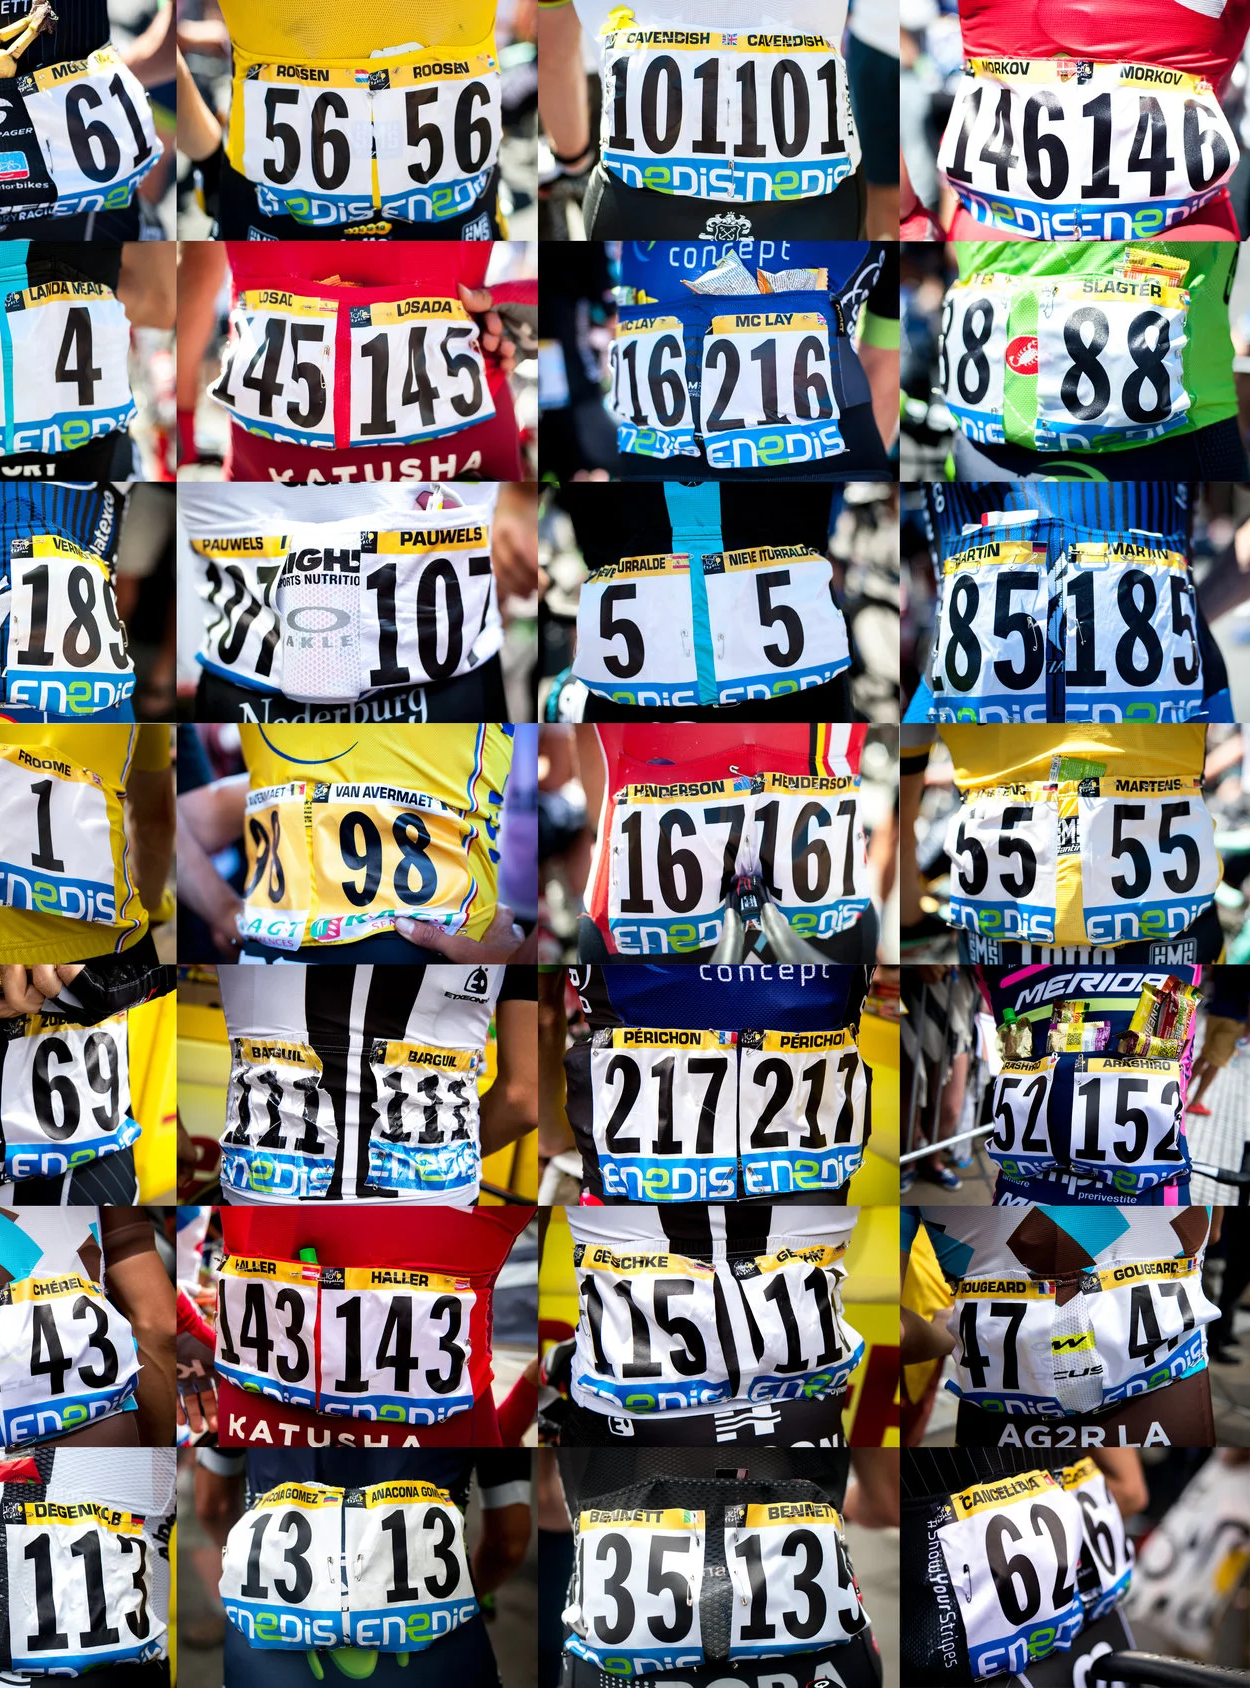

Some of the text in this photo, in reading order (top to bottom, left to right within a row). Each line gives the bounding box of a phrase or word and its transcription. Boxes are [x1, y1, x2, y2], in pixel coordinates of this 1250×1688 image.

[277, 65, 329, 81] ROOSEN
[413, 62, 470, 79] ROOSEN
[627, 32, 710, 44] CAVENDISH
[747, 33, 824, 47] CAVENDISH
[981, 60, 1030, 75] MORKOV
[1119, 65, 1183, 85] MORKOV
[66, 72, 153, 183] 61
[263, 87, 351, 190] 56
[405, 81, 491, 184] 56
[609, 55, 727, 154] 101
[733, 59, 846, 158] 101
[946, 86, 1069, 200] 146
[1081, 92, 1230, 199] 146
[29, 282, 70, 301] LANDA
[670, 241, 790, 267] concept
[1083, 280, 1162, 298] SLAGTER
[397, 302, 451, 316] LOSADA
[636, 319, 656, 329] LAY
[736, 314, 793, 327] MC LAY
[55, 307, 102, 405] 4
[212, 318, 326, 428] 145
[360, 327, 482, 435] 145
[705, 335, 833, 433] 216
[1060, 307, 1172, 423] 88
[203, 536, 263, 551] PAUWELS
[400, 527, 482, 546] PAUWELS
[1109, 543, 1169, 560] MARTIN
[600, 583, 645, 678] 5
[756, 570, 805, 667] 5
[1065, 569, 1199, 687] 185
[18, 749, 71, 777] FROOME
[336, 786, 433, 808] VAN AVERMAET
[634, 781, 725, 798] HENDERSON
[1116, 779, 1181, 793] MARTENS
[31, 779, 65, 872] 1
[339, 811, 438, 907] 98
[621, 805, 745, 914] 167
[754, 800, 856, 902] 167
[955, 807, 1037, 898] 55
[1111, 801, 1200, 900] 55
[700, 965, 829, 986] concept
[1015, 973, 1168, 1011] MERIDA
[252, 1047, 305, 1062] BARGUIL
[408, 1050, 457, 1067] BARGUIL
[624, 1029, 701, 1045] PÉRICHON
[1103, 1060, 1170, 1071] ARASHIRO
[32, 1032, 119, 1141] 69
[606, 1055, 728, 1155] 217
[750, 1051, 859, 1149] 217
[1075, 1077, 1183, 1163] 152
[1078, 1190, 1137, 1204] prerivestite
[34, 1277, 84, 1296] CHÉREL
[371, 1272, 429, 1287] HALLER
[593, 1250, 669, 1269] GESCHKE
[1114, 1262, 1179, 1281] GOUGEARD
[30, 1295, 119, 1396] 43
[218, 1279, 310, 1383] 143
[335, 1295, 467, 1395] 143
[581, 1274, 707, 1378] 115
[959, 1301, 1027, 1390] 47
[998, 1421, 1171, 1447] AG2R LA
[286, 1489, 318, 1504] GOMEZ
[371, 1487, 419, 1503] ANACONA
[590, 1510, 664, 1524] BENNETT
[25, 1530, 150, 1652] 113
[241, 1511, 313, 1604] 13
[382, 1507, 460, 1603] 13
[735, 1529, 867, 1640] 135
[927, 1520, 957, 1669] #ShowYourStripes
[986, 1504, 1075, 1626] 62
